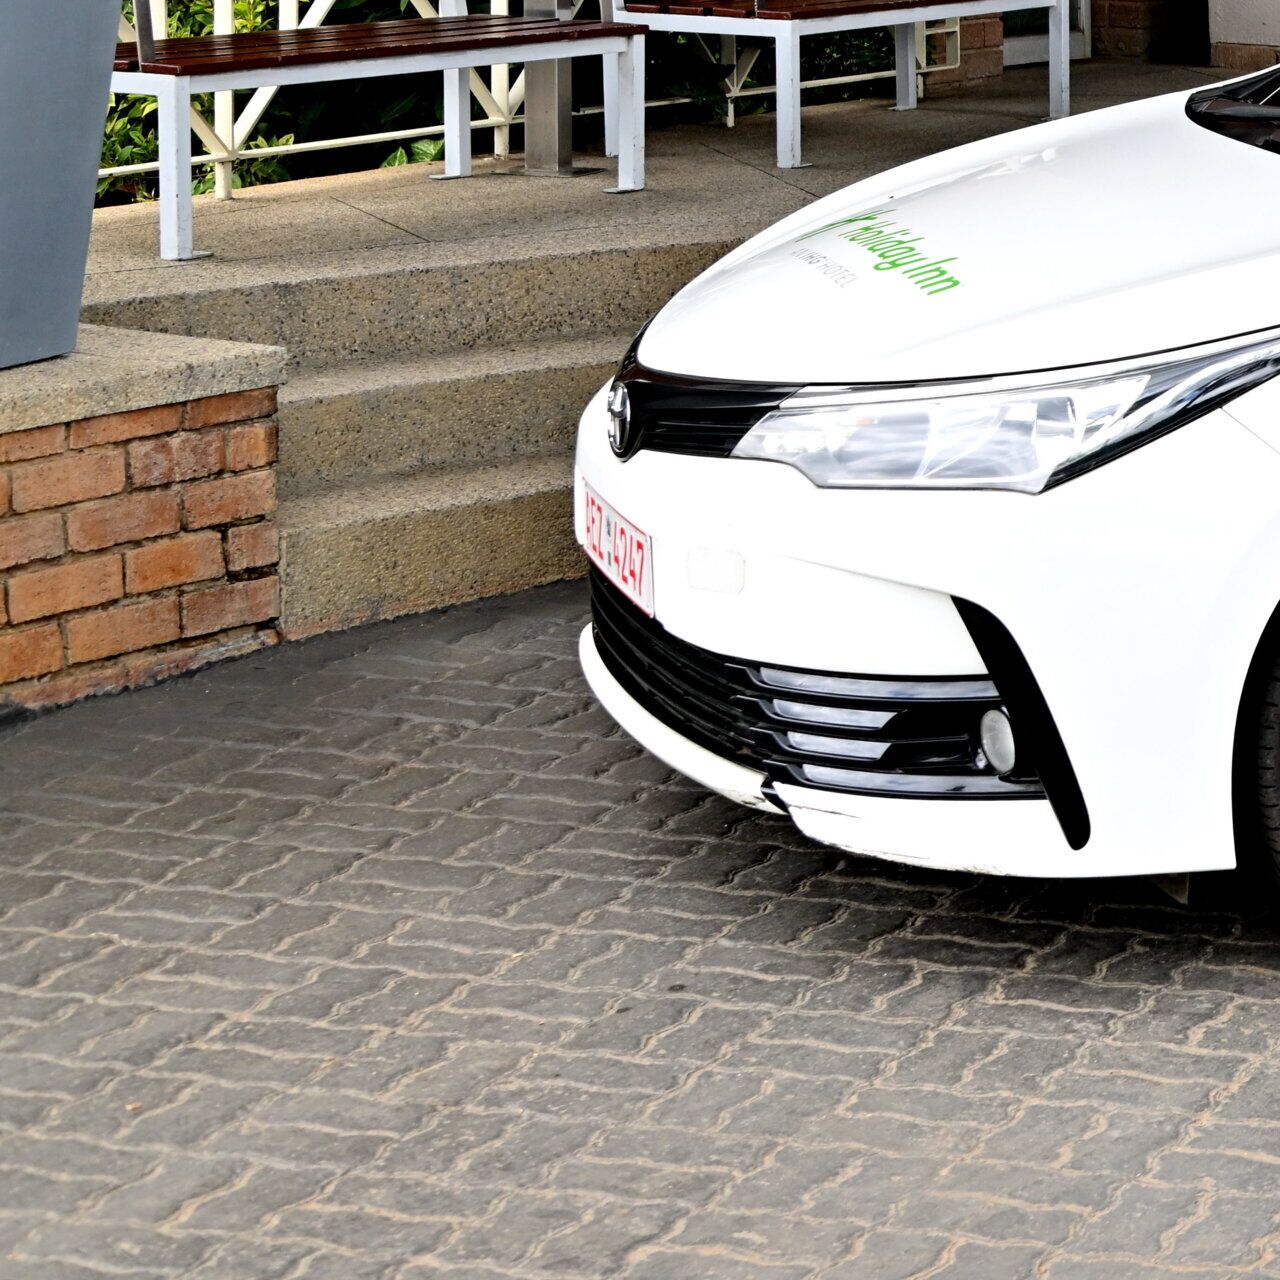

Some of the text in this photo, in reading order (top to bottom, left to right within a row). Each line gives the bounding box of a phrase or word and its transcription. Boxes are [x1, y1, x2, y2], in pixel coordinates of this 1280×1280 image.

[818, 258, 859, 289] HOTEL
[838, 220, 961, 296] Holiday Inn
[613, 521, 645, 596] 4247
